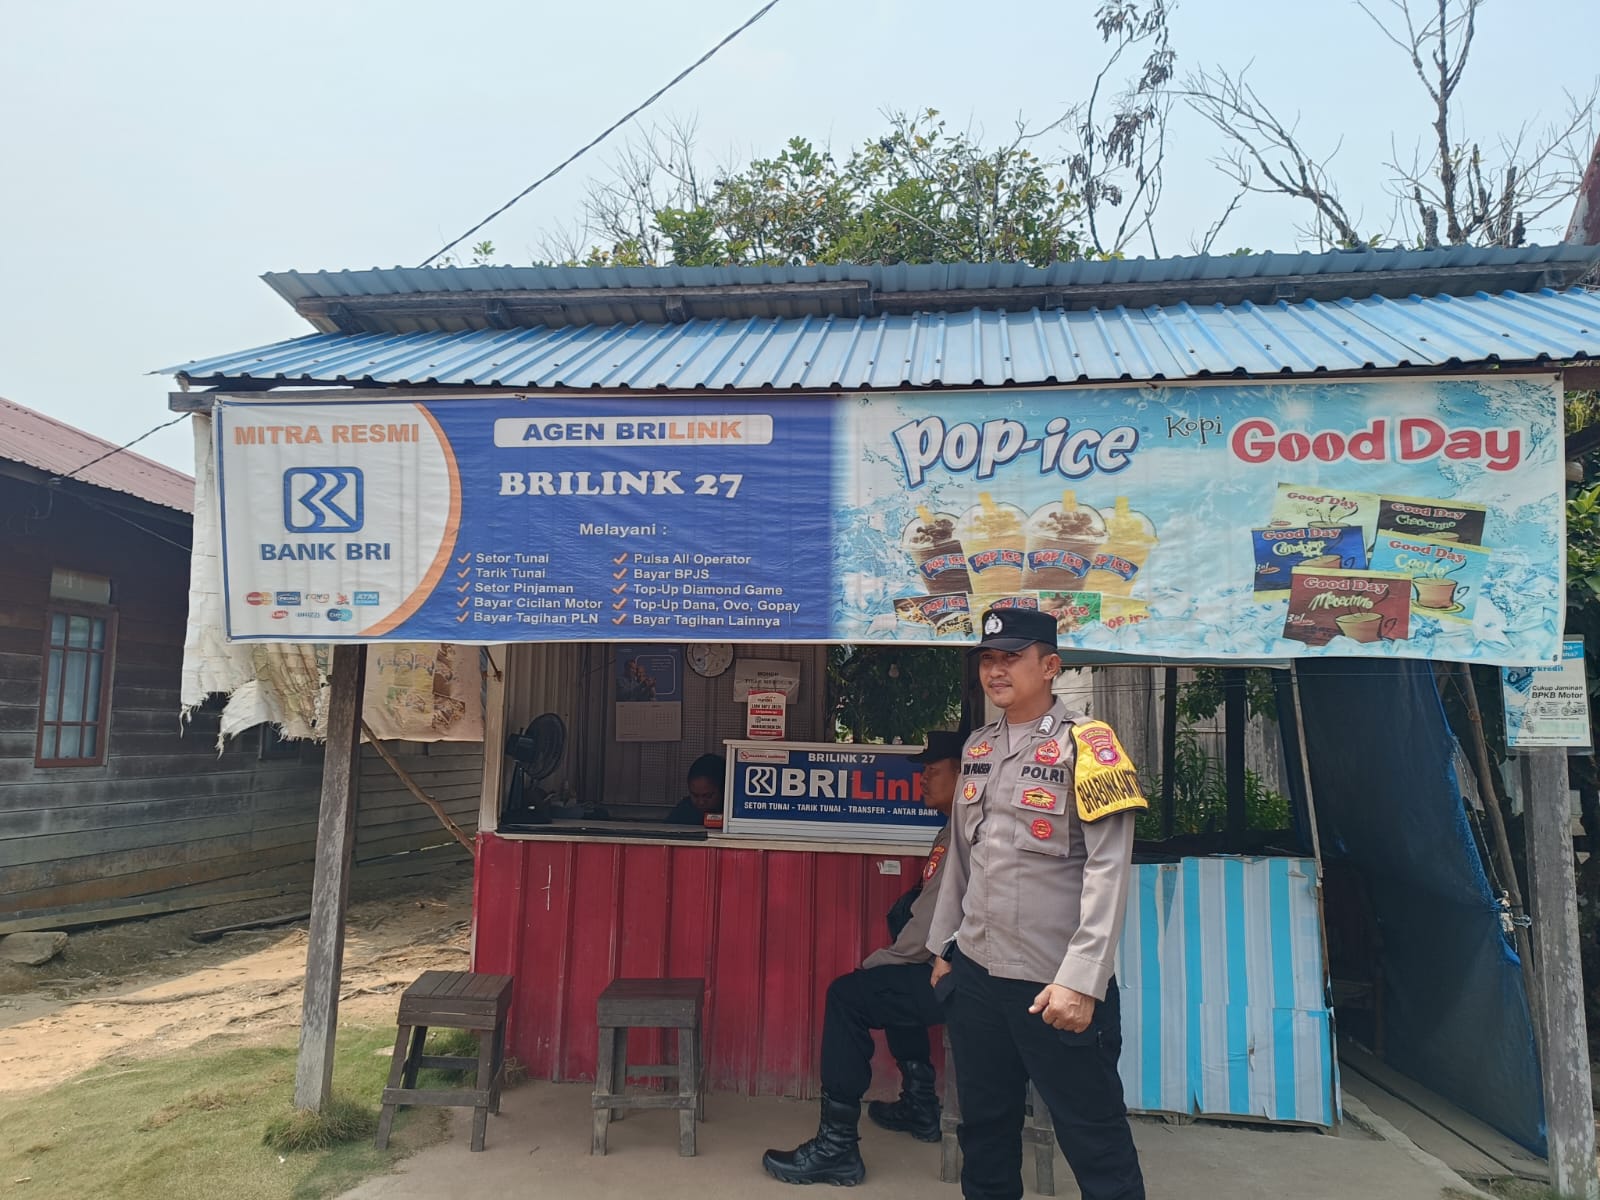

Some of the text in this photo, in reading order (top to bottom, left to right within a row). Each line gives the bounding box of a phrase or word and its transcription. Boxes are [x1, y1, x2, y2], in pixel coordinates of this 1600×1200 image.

[234, 424, 419, 445] MITRA RESMI
[522, 420, 742, 441] AGEN BRILINK
[1166, 416, 1222, 445] Kopi
[1231, 418, 1520, 471] Good Day
[499, 471, 743, 498] BRILINK 27
[1287, 493, 1325, 503] Good
[1391, 503, 1467, 520] Good Day
[579, 524, 656, 537] Melayani
[1263, 527, 1341, 540] Good Day
[260, 542, 391, 560] BANK BRI
[476, 553, 549, 563] Setor Tunai
[1389, 540, 1466, 564] Good Day
[634, 554, 752, 565] Pulsa All Operator
[975, 551, 997, 567] POP
[475, 568, 546, 578] Tarik Tunai
[634, 569, 710, 581] Bayar BPJS
[474, 583, 574, 595] Setor Pinjaman
[634, 583, 783, 596] Top-Up Diamond Game
[1304, 577, 1389, 594] Good Day
[474, 597, 603, 609] Bayar Cicilan Motor
[633, 598, 801, 613] Top-Up Dana, Ovo, Gopay
[474, 612, 598, 625] Bayar Tagihan PLN
[633, 614, 781, 628] Bayar Tagihan Lainnya
[1531, 691, 1556, 699] BPKB
[808, 752, 876, 764] BRILINK 27
[1020, 765, 1065, 783] POLRI
[744, 801, 767, 810] SETOR
[769, 802, 790, 811] TUNAI
[797, 803, 818, 811] TARIK
[820, 804, 841, 812] TUNAI
[848, 805, 885, 814] TRANSFER
[893, 807, 916, 816] ANTAR
[918, 808, 938, 816] BANK
